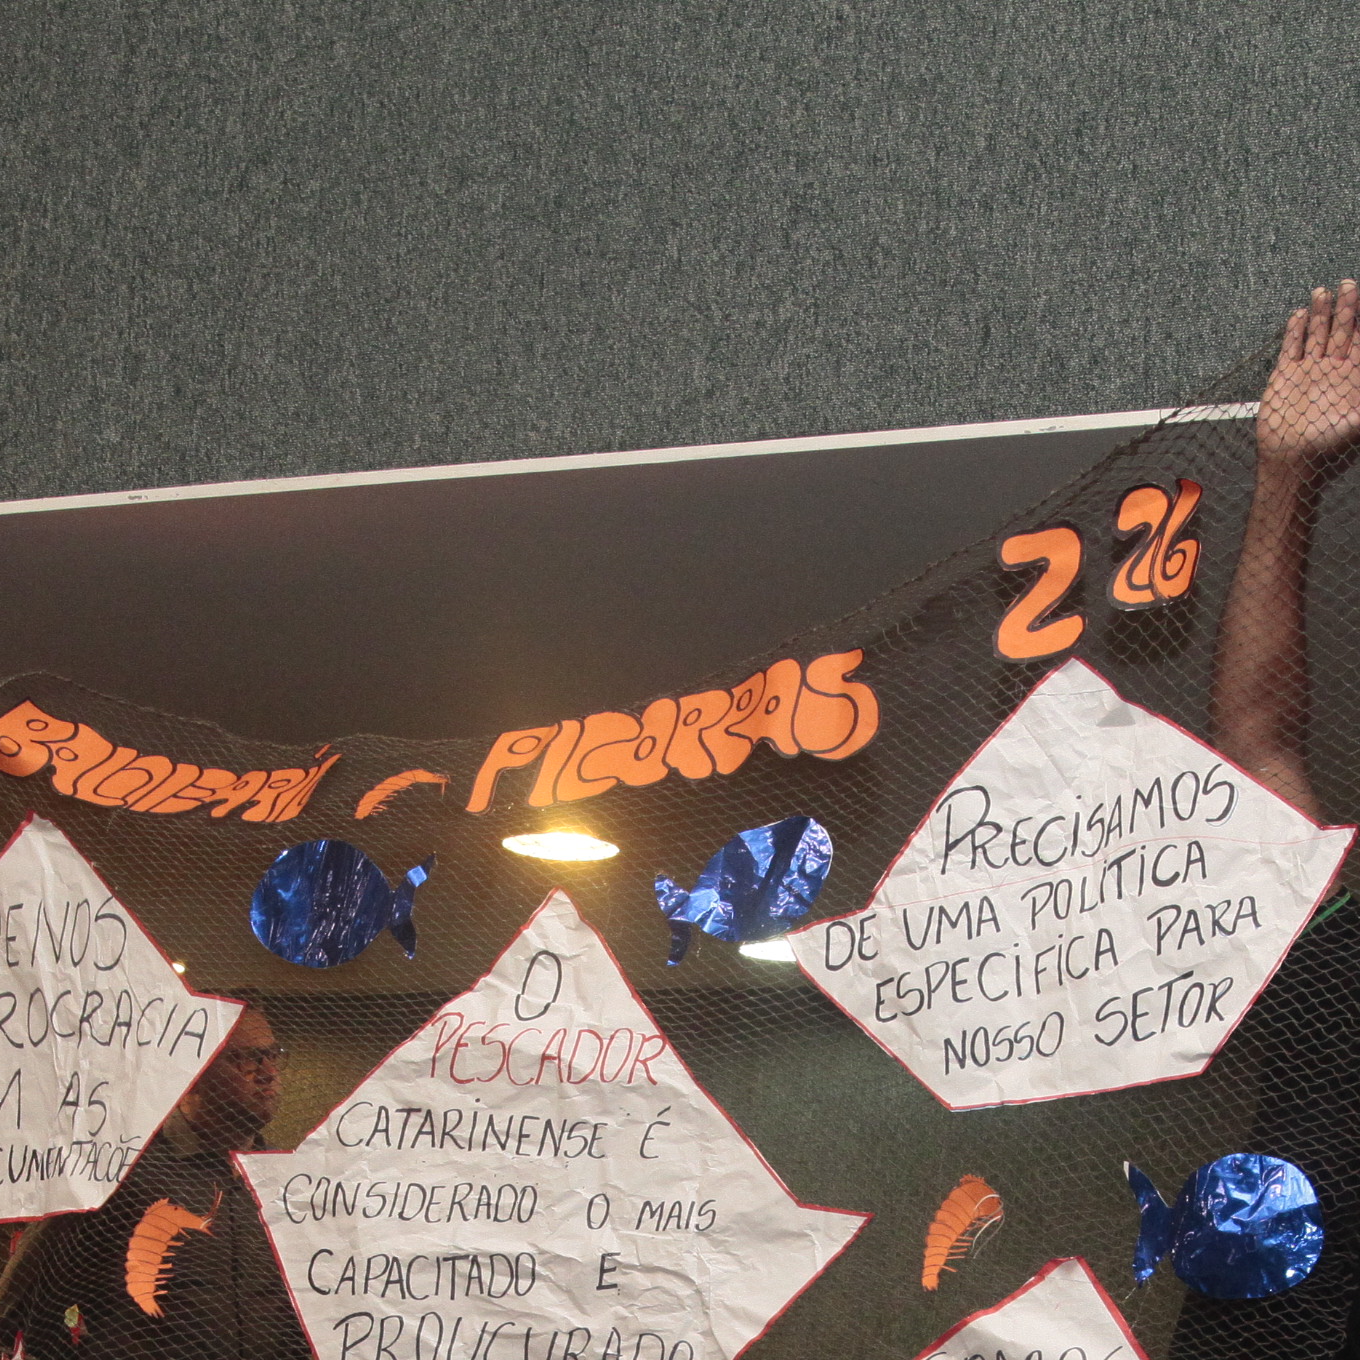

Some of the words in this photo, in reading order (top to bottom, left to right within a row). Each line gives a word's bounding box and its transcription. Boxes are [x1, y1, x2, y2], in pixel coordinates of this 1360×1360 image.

[1107, 480, 1202, 611] 26
[824, 913, 880, 972] DE
[903, 895, 1002, 951] UMA
[1147, 895, 1262, 957] PARA
[515, 950, 563, 1021] O
[428, 1011, 668, 1086] PESCADOR
[943, 1012, 1065, 1075] NOSSO
[1094, 970, 1234, 1047] SETOR
[58, 1071, 111, 1137] AS
[336, 1098, 609, 1159] CATARINENSE
[639, 1106, 672, 1159] É
[282, 1172, 537, 1224] CONSIDERADO
[586, 1193, 611, 1229] O
[635, 1199, 718, 1233] MAIS
[307, 1248, 537, 1301] CAPACITADO
[596, 1251, 622, 1292] E
